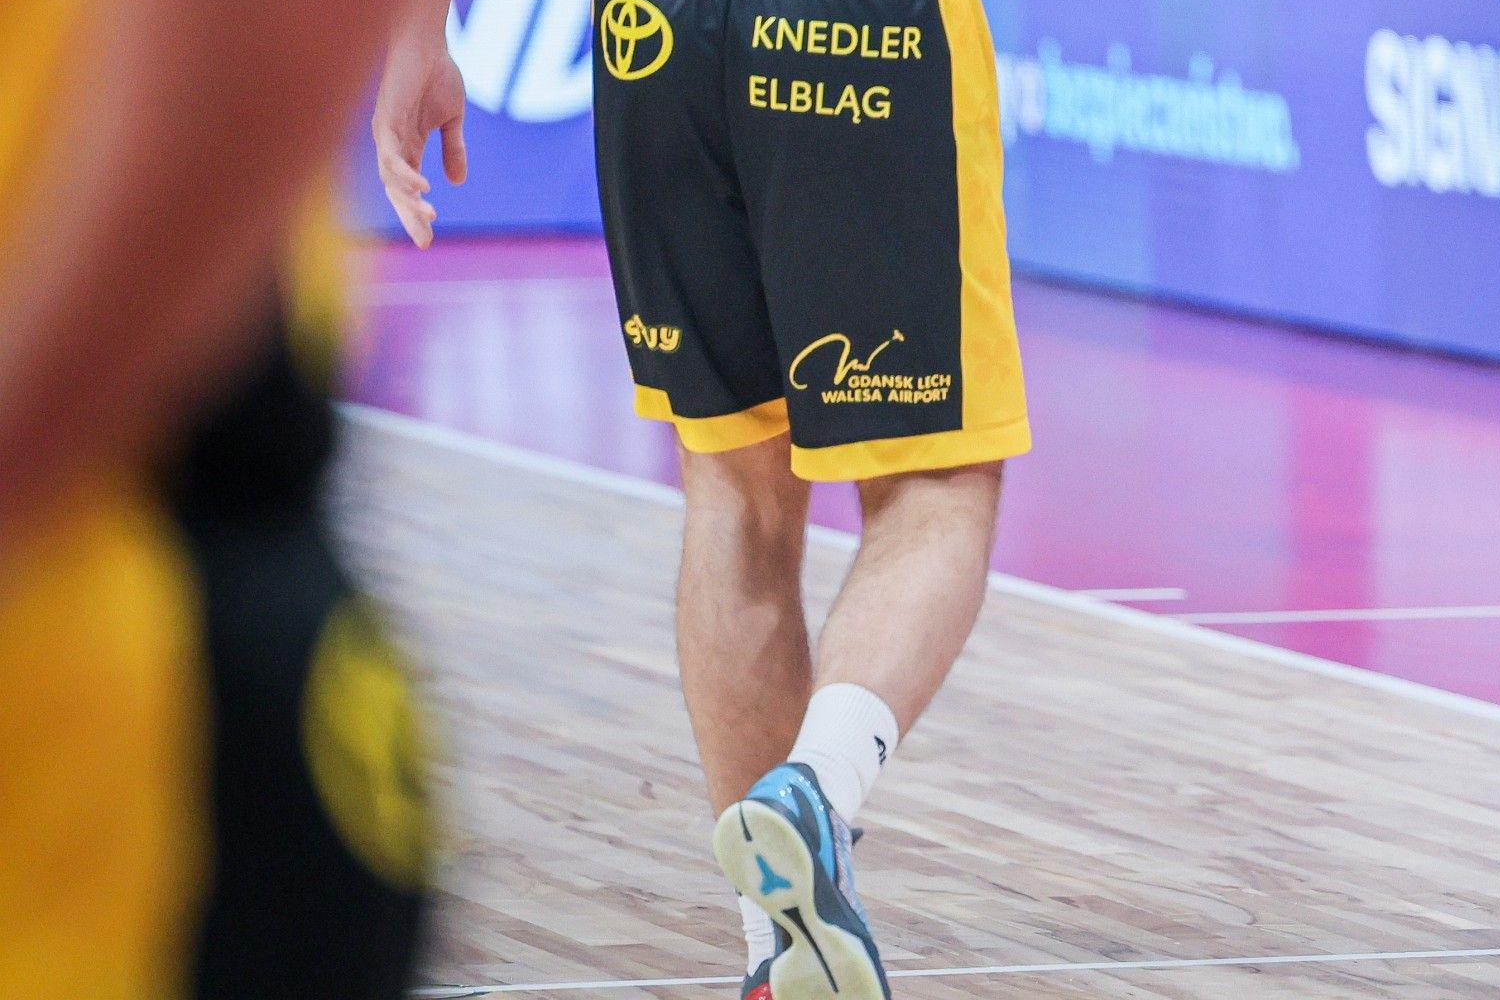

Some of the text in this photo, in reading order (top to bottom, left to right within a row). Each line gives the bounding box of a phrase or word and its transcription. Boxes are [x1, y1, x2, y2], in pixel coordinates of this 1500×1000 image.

[751, 15, 922, 60] KNEDLER
[748, 75, 892, 124] ELBLĄG
[848, 375, 914, 389] GDANSK
[888, 388, 949, 403] AIRPORT
